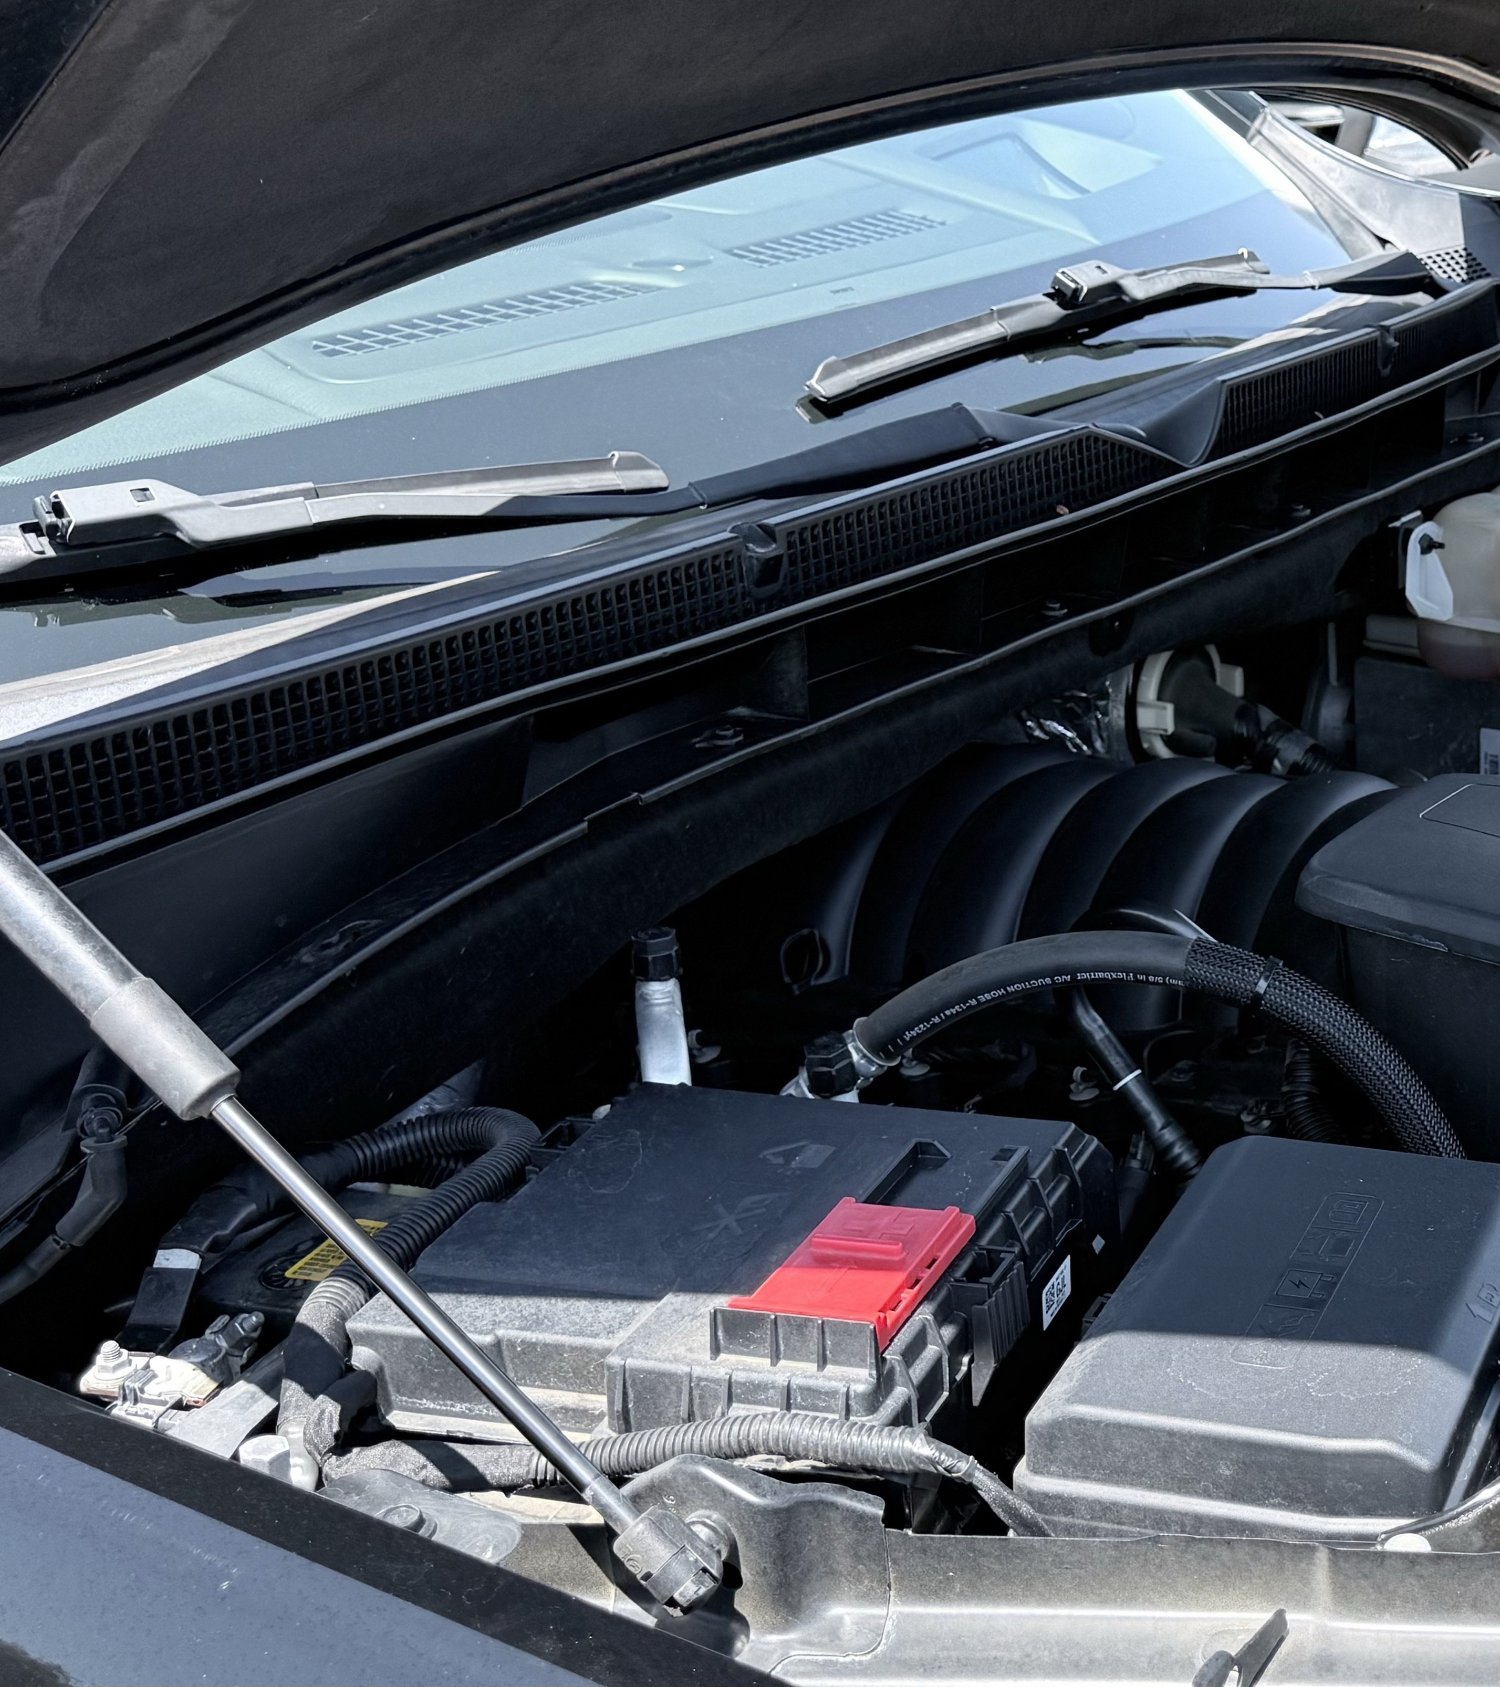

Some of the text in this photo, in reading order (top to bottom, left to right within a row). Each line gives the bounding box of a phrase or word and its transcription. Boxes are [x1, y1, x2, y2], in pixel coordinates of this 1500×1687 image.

[1054, 974, 1071, 984] A/C
[1076, 971, 1135, 981] Flexbarrier
[1007, 977, 1052, 993] SUCTION
[977, 989, 1006, 1003] HOSE
[946, 998, 977, 1016] R-134a
